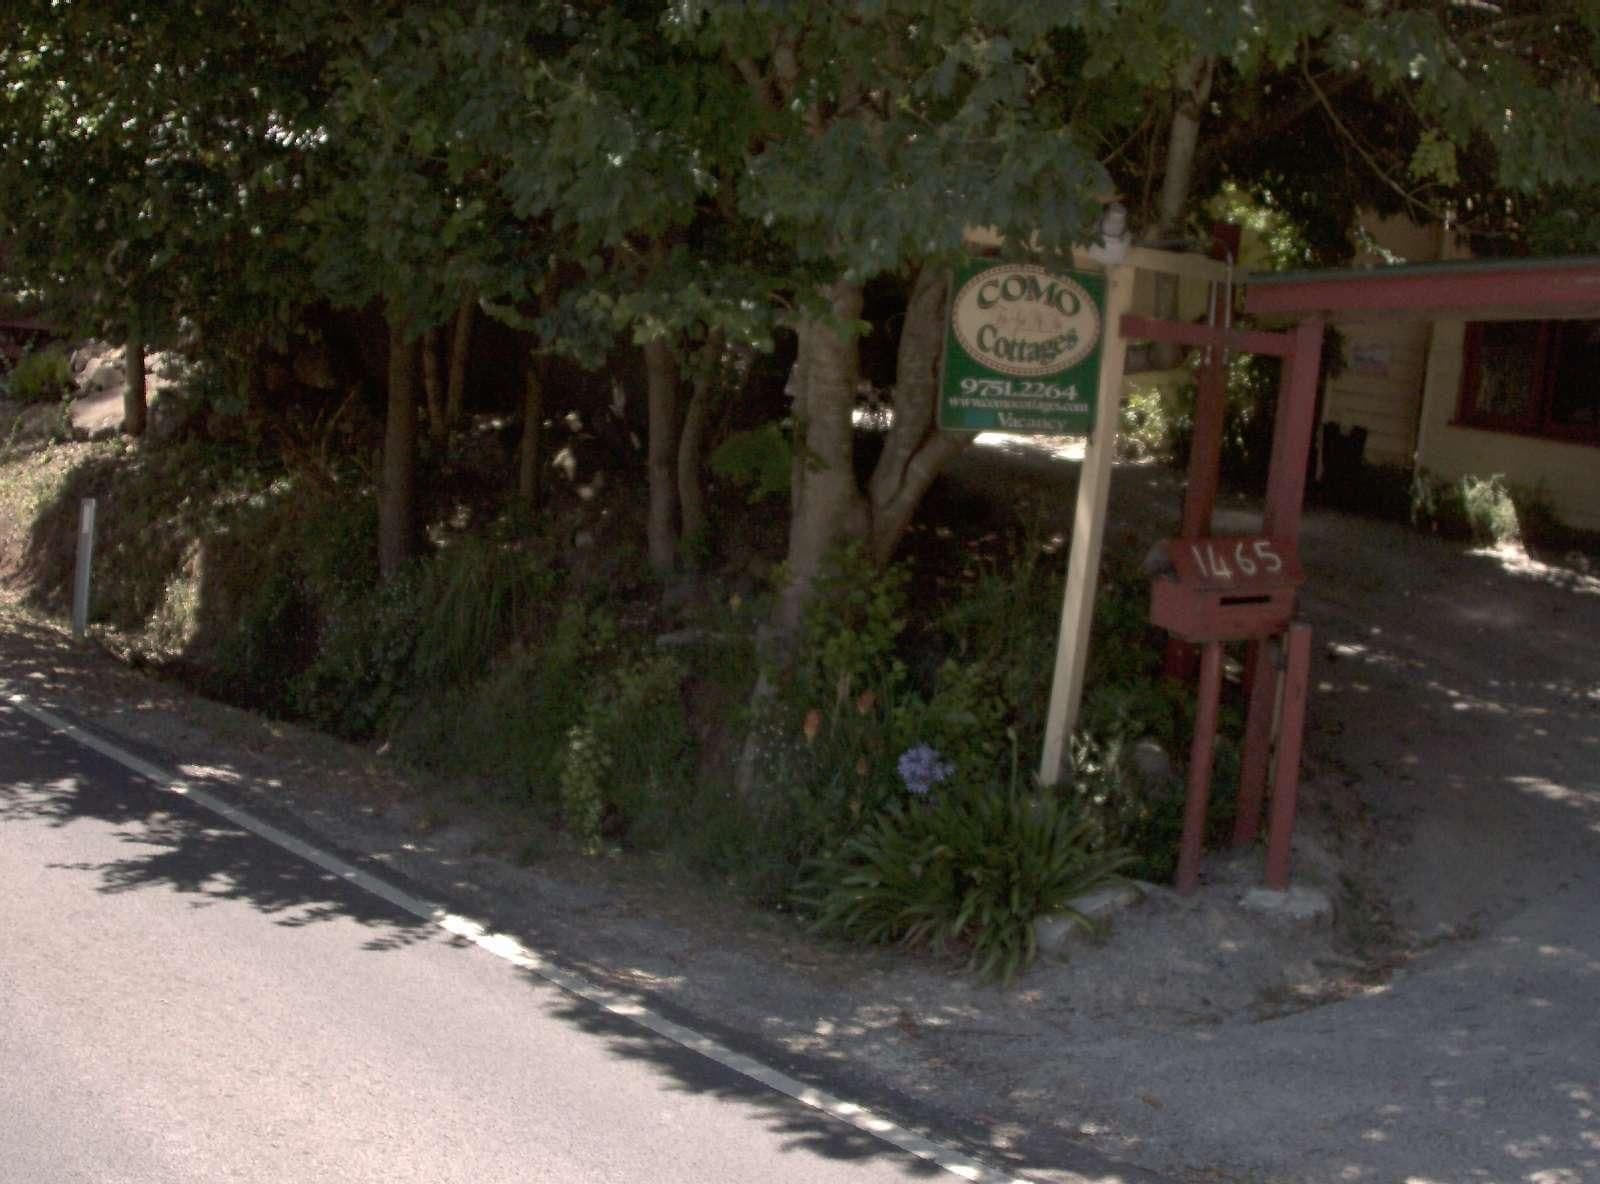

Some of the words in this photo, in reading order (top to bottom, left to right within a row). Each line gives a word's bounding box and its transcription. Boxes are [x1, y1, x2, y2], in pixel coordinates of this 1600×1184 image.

[976, 274, 1081, 317] COMO
[976, 324, 1079, 367] Cottages
[997, 412, 1067, 431] Vacancy
[1191, 541, 1282, 579] 1465
